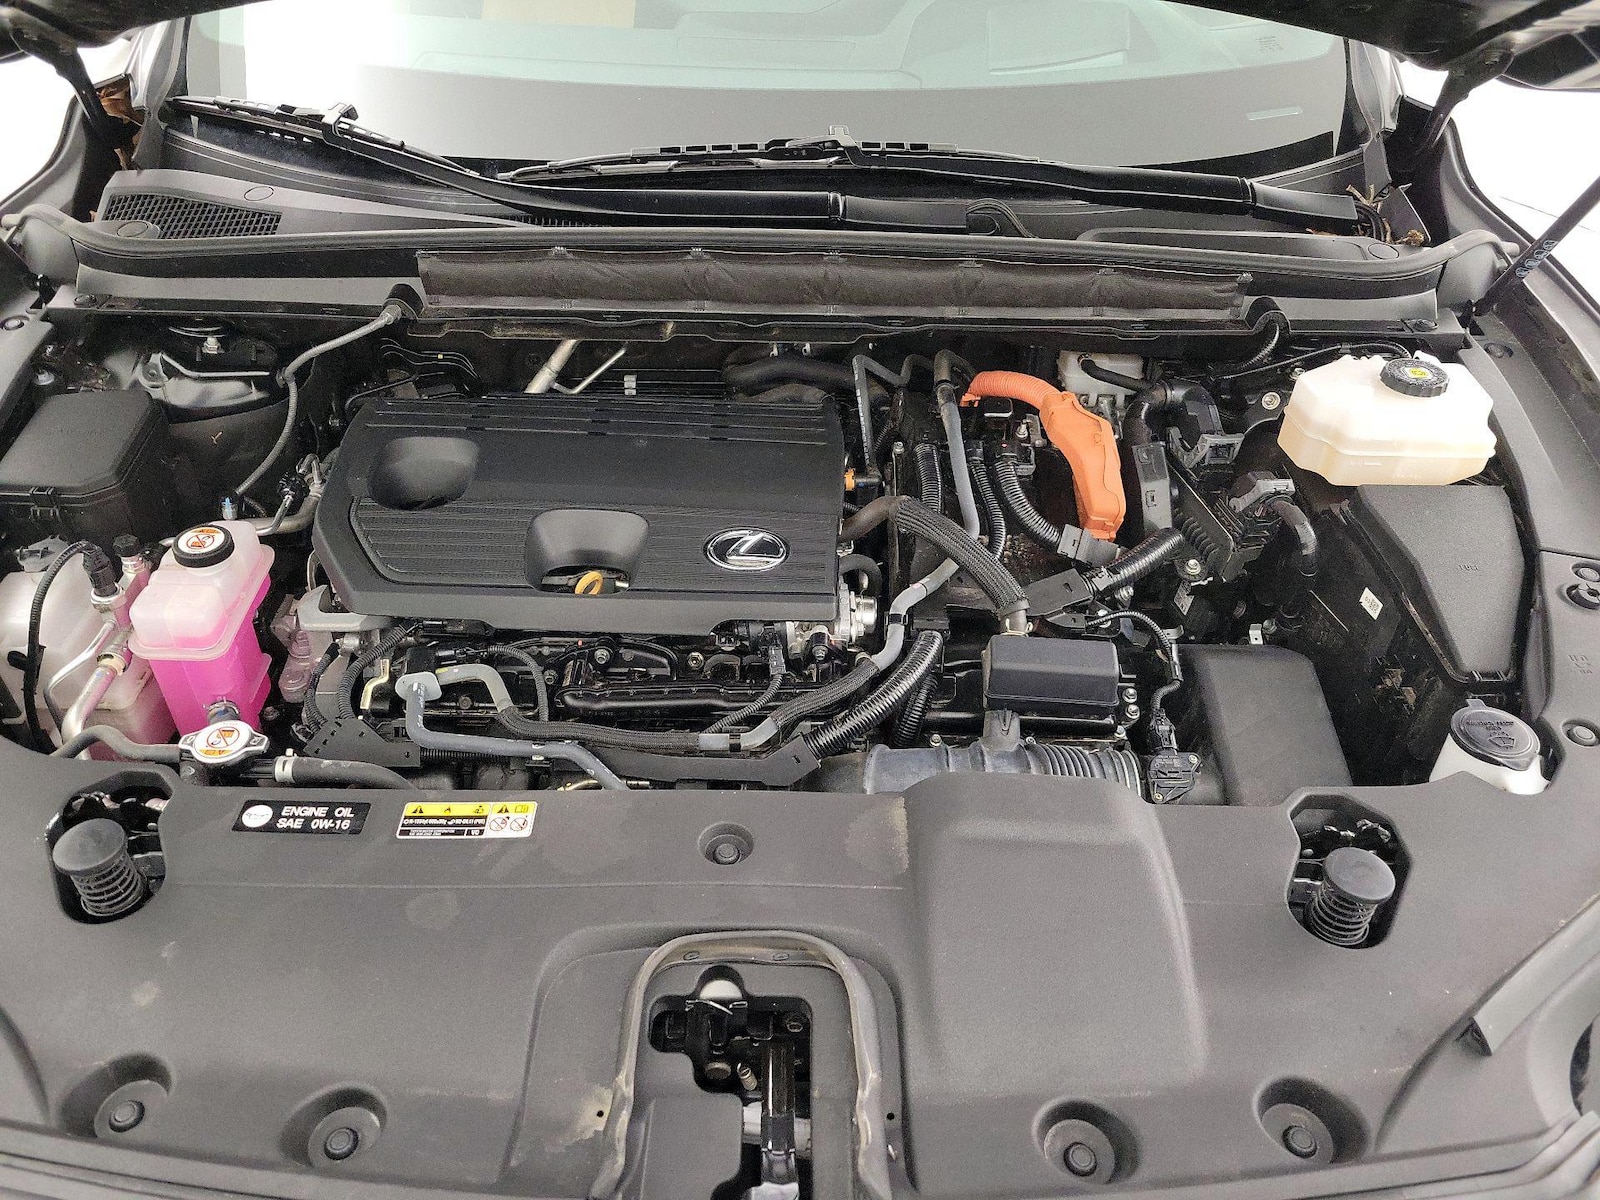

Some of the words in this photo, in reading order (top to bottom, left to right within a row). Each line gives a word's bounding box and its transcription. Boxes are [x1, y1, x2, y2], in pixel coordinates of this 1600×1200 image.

[281, 805, 329, 817] ENGINE
[334, 806, 355, 818] OIL
[276, 817, 305, 829] SAE
